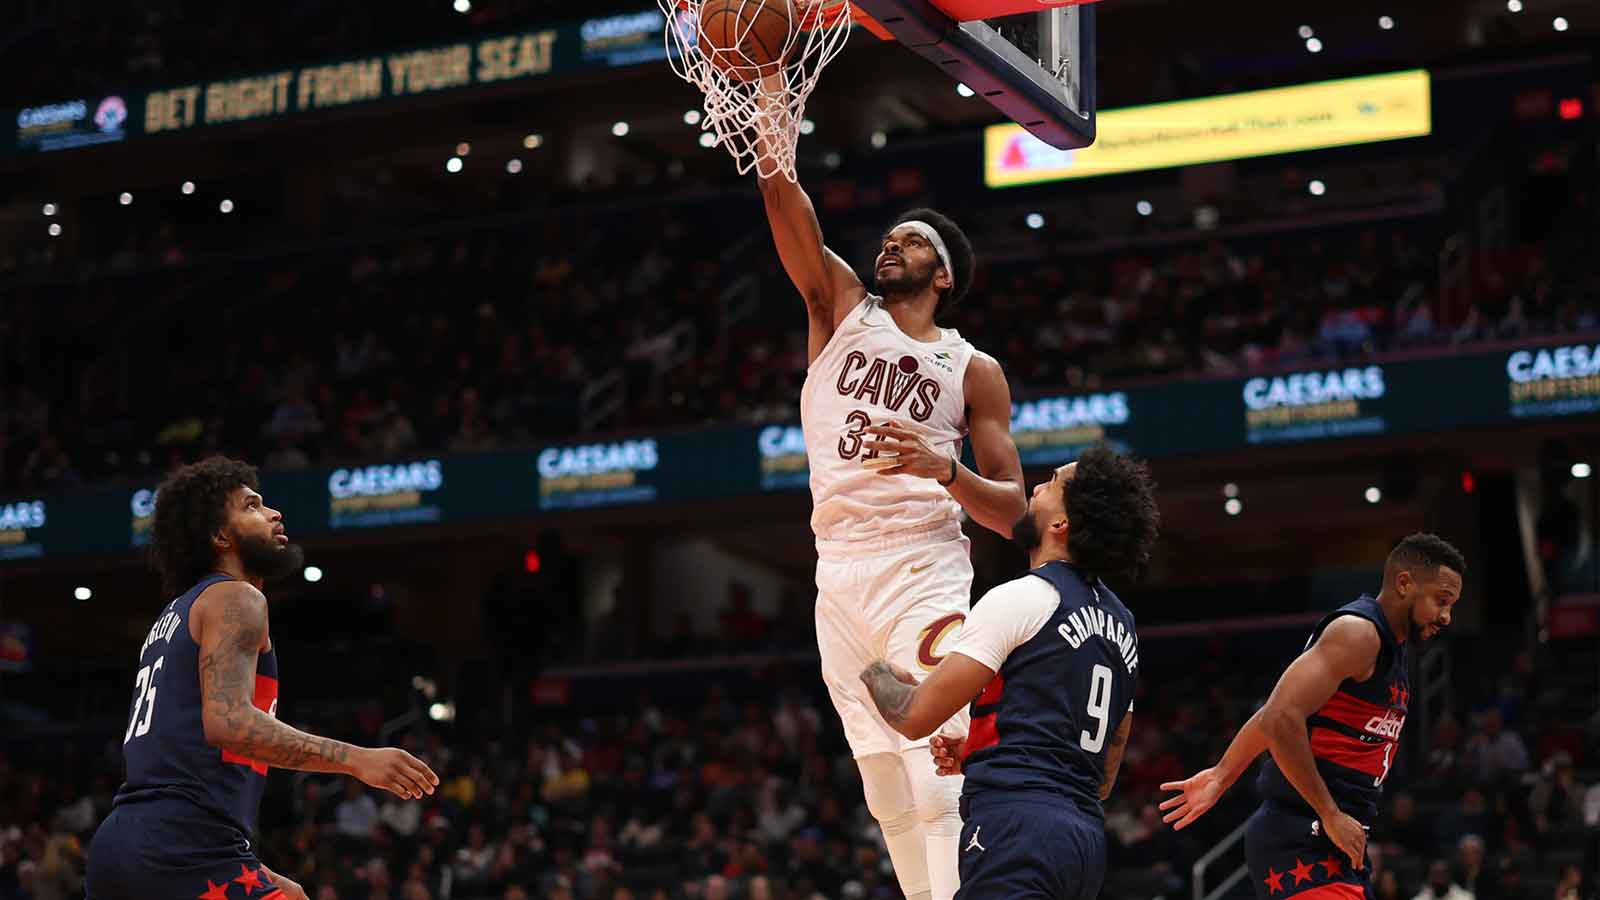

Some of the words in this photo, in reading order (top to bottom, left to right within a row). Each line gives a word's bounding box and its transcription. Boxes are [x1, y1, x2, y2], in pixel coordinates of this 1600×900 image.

[145, 87, 200, 134] BET
[205, 72, 293, 125] RIGHT
[297, 57, 382, 110] FROM
[388, 43, 470, 96] YOUR
[476, 30, 556, 83] SEAT
[837, 350, 941, 423] CAVS
[1243, 366, 1385, 410] CAESARS
[328, 460, 443, 498] CAESARS
[537, 439, 658, 479] CAESARS
[1057, 605, 1138, 675] CHAMPAGNIE
[1079, 663, 1113, 754] 9
